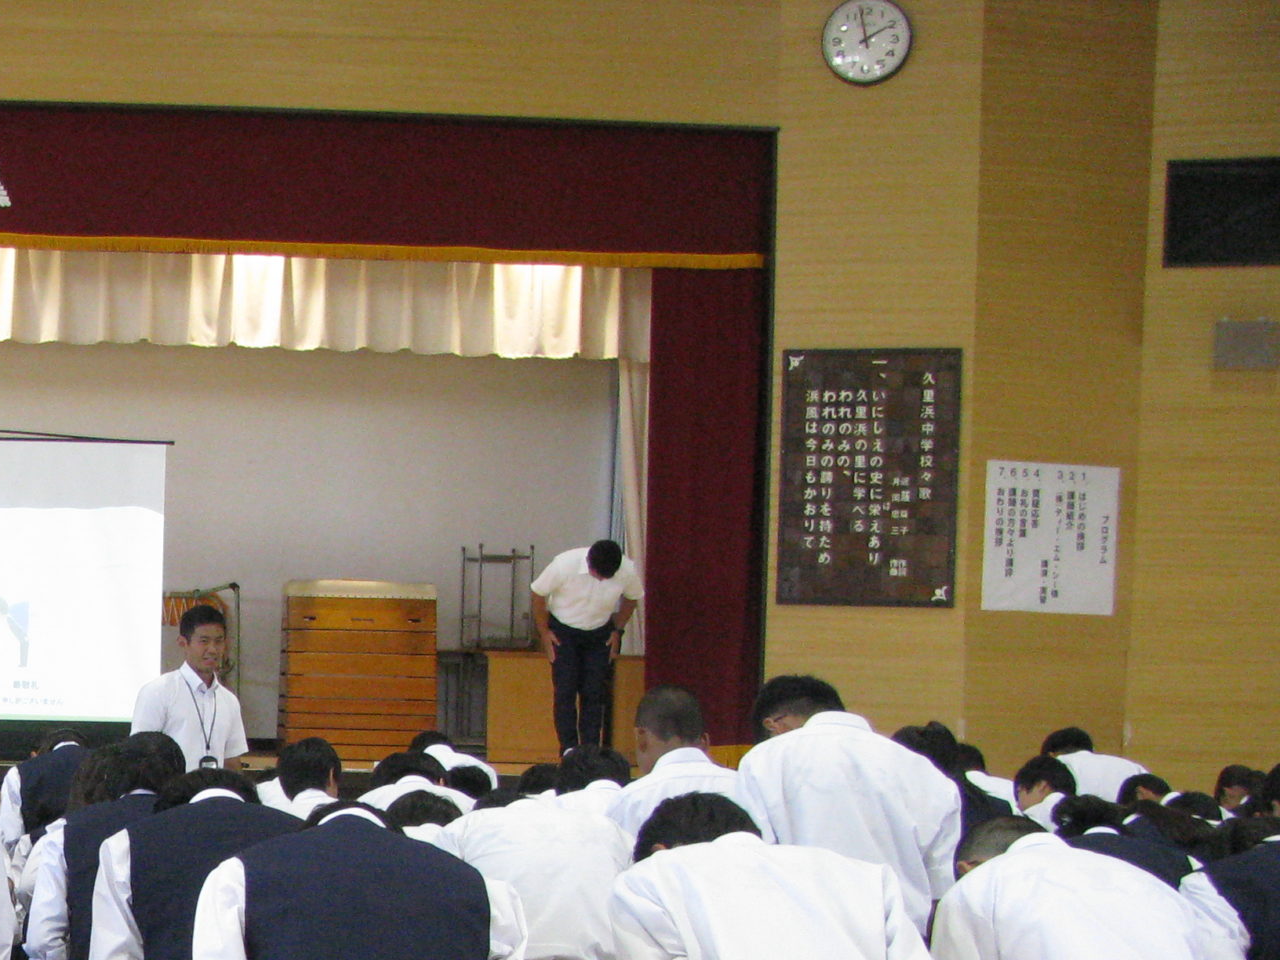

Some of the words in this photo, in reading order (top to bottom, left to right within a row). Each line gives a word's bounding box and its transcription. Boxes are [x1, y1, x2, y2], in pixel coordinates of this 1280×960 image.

[919, 372, 935, 499] 久里浜中学校々歌
